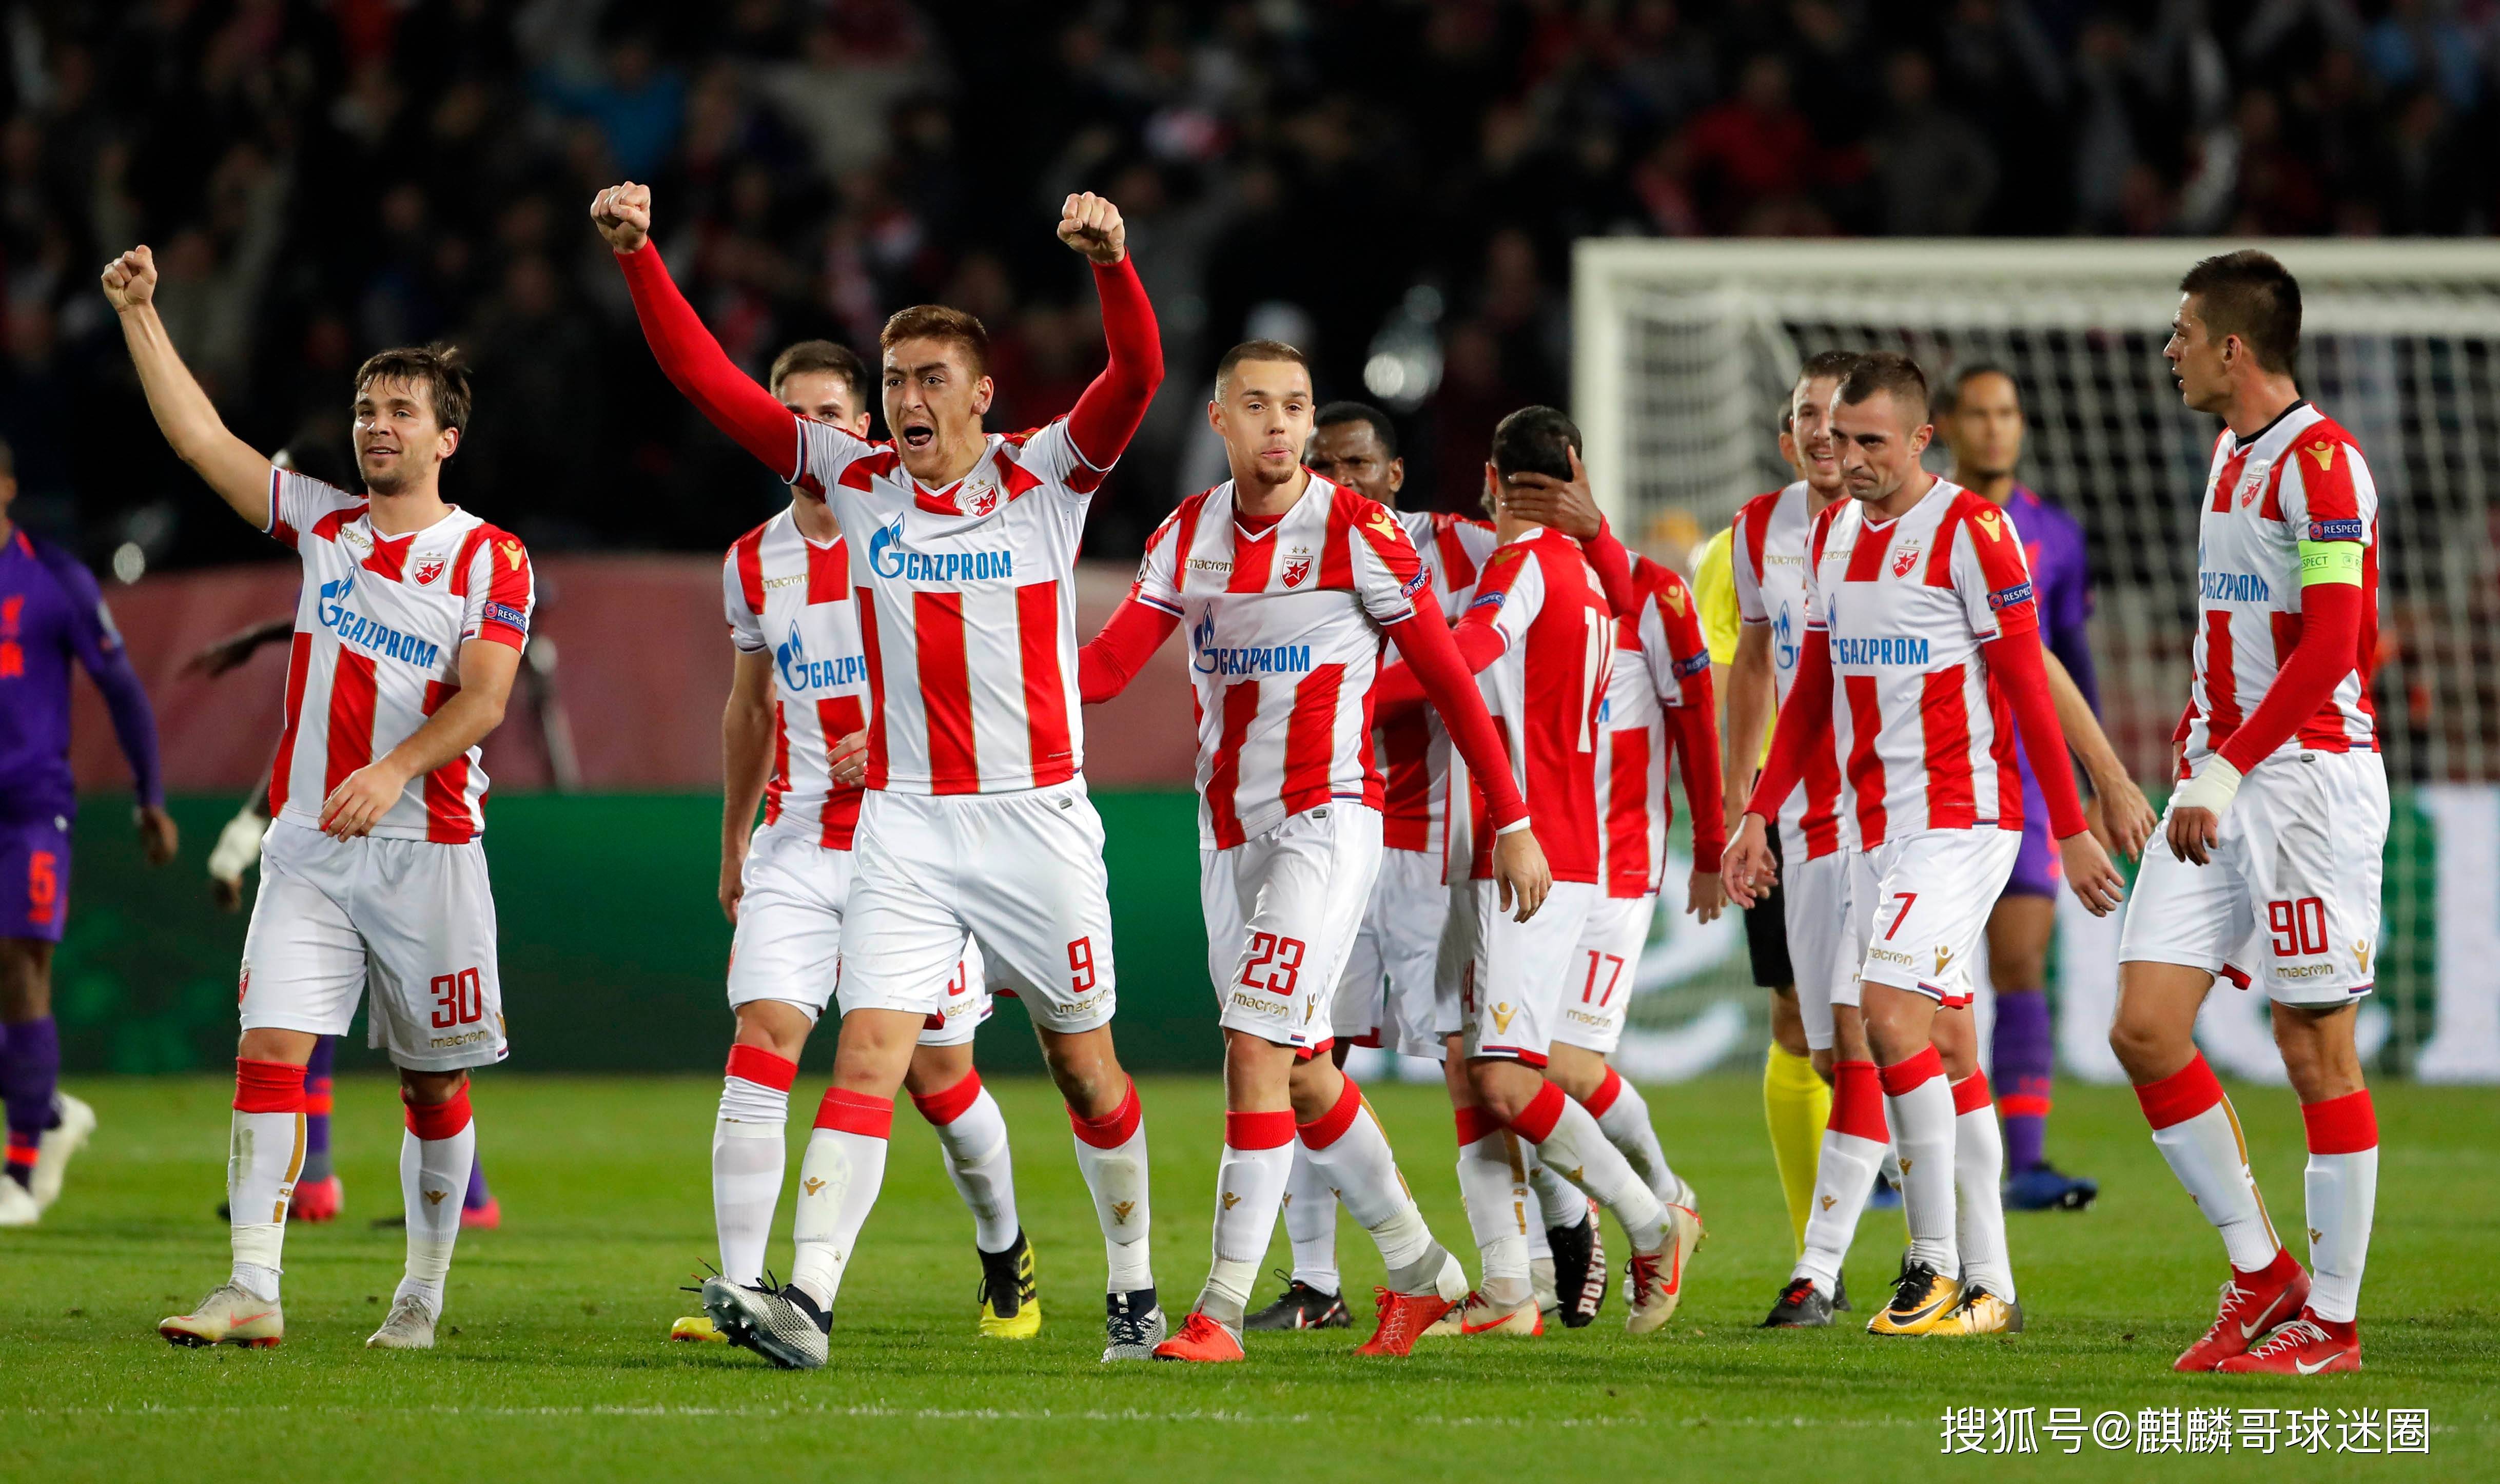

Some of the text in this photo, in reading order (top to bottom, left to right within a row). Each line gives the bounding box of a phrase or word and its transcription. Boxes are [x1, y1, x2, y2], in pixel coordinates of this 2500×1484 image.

[2323, 524, 2361, 534] RESPECT
[906, 550, 1012, 581] GAZPROM
[1185, 557, 1233, 572] macron
[2301, 556, 2329, 569] SPECT
[763, 573, 808, 590] macron
[338, 610, 439, 670] GAZPROM
[1839, 638, 1929, 665] GAZPROM
[1219, 645, 1310, 675] GAZPROM
[1885, 892, 1918, 941] 7
[2268, 896, 2329, 957] 90
[1067, 935, 1096, 993] 9
[1240, 931, 1306, 997] 23
[2276, 963, 2334, 979] macron
[1582, 949, 1626, 1007] 17
[430, 967, 482, 1029] 30
[1060, 989, 1108, 1014] macron
[1233, 992, 1290, 1017] macron
[1566, 1009, 1612, 1029] macron
[431, 1030, 488, 1049] macron
